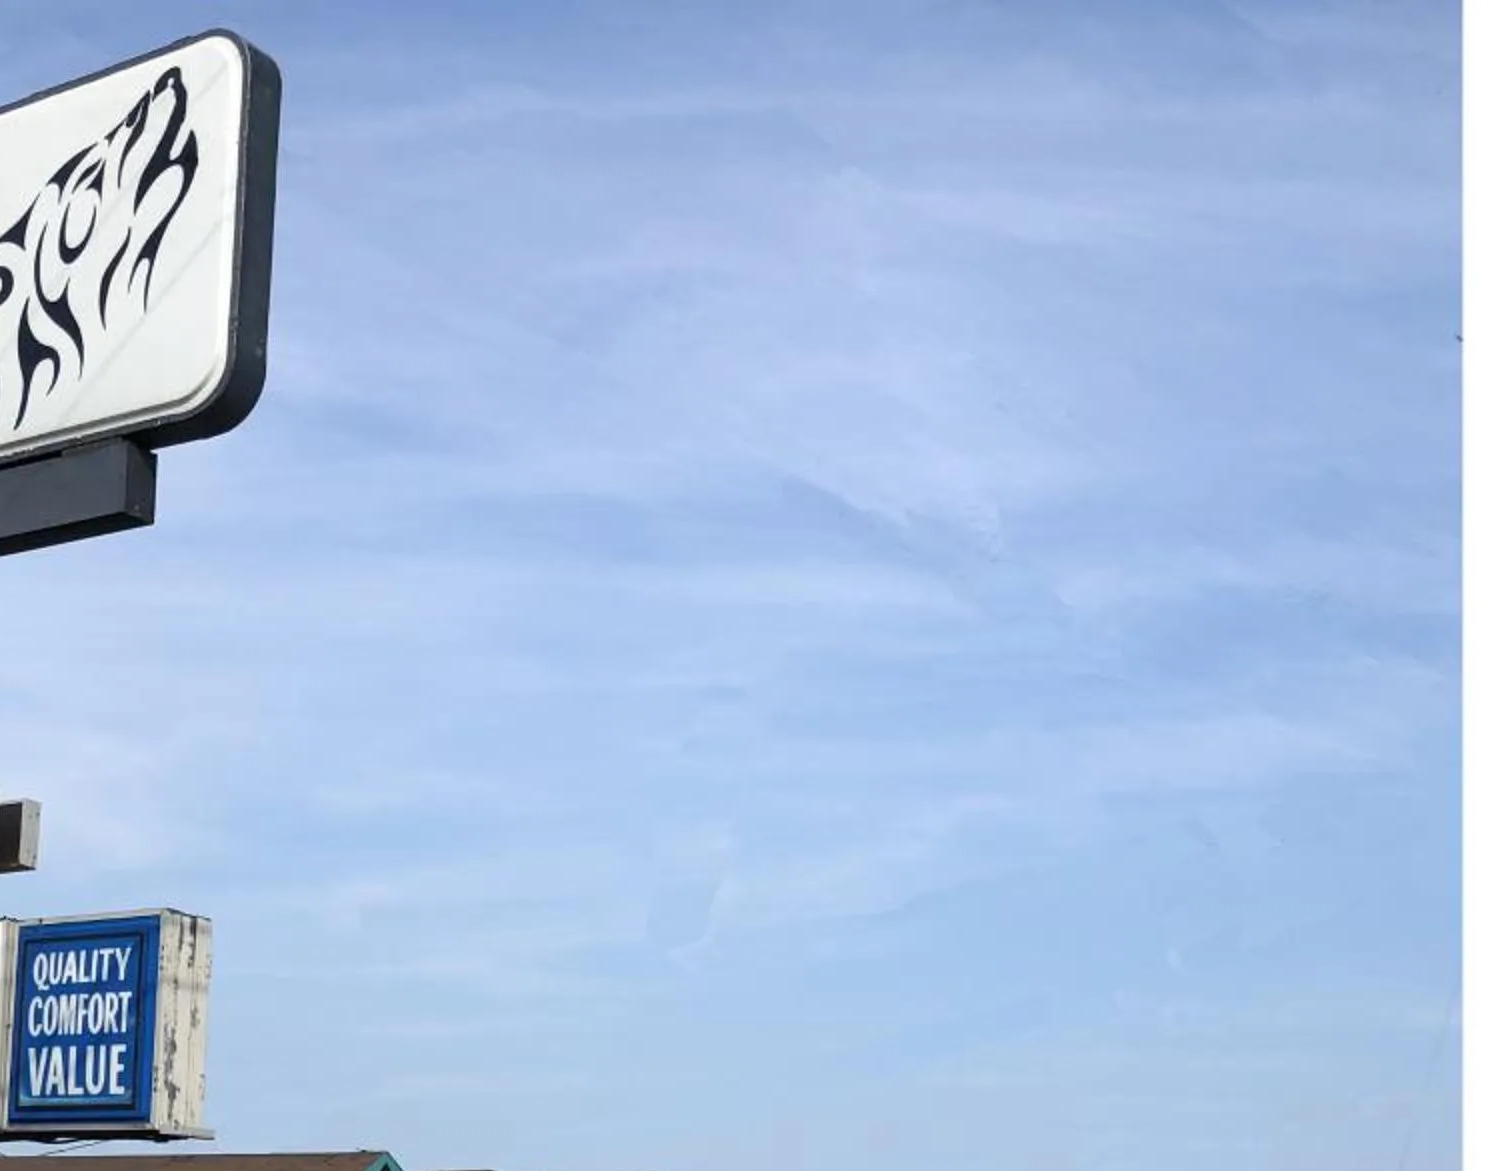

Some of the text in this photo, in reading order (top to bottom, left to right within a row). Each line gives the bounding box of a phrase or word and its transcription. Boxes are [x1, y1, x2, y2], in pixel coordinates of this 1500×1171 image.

[33, 947, 132, 991] QUALITY
[28, 991, 132, 1037] COMFORT
[27, 1043, 127, 1096] VALUE
